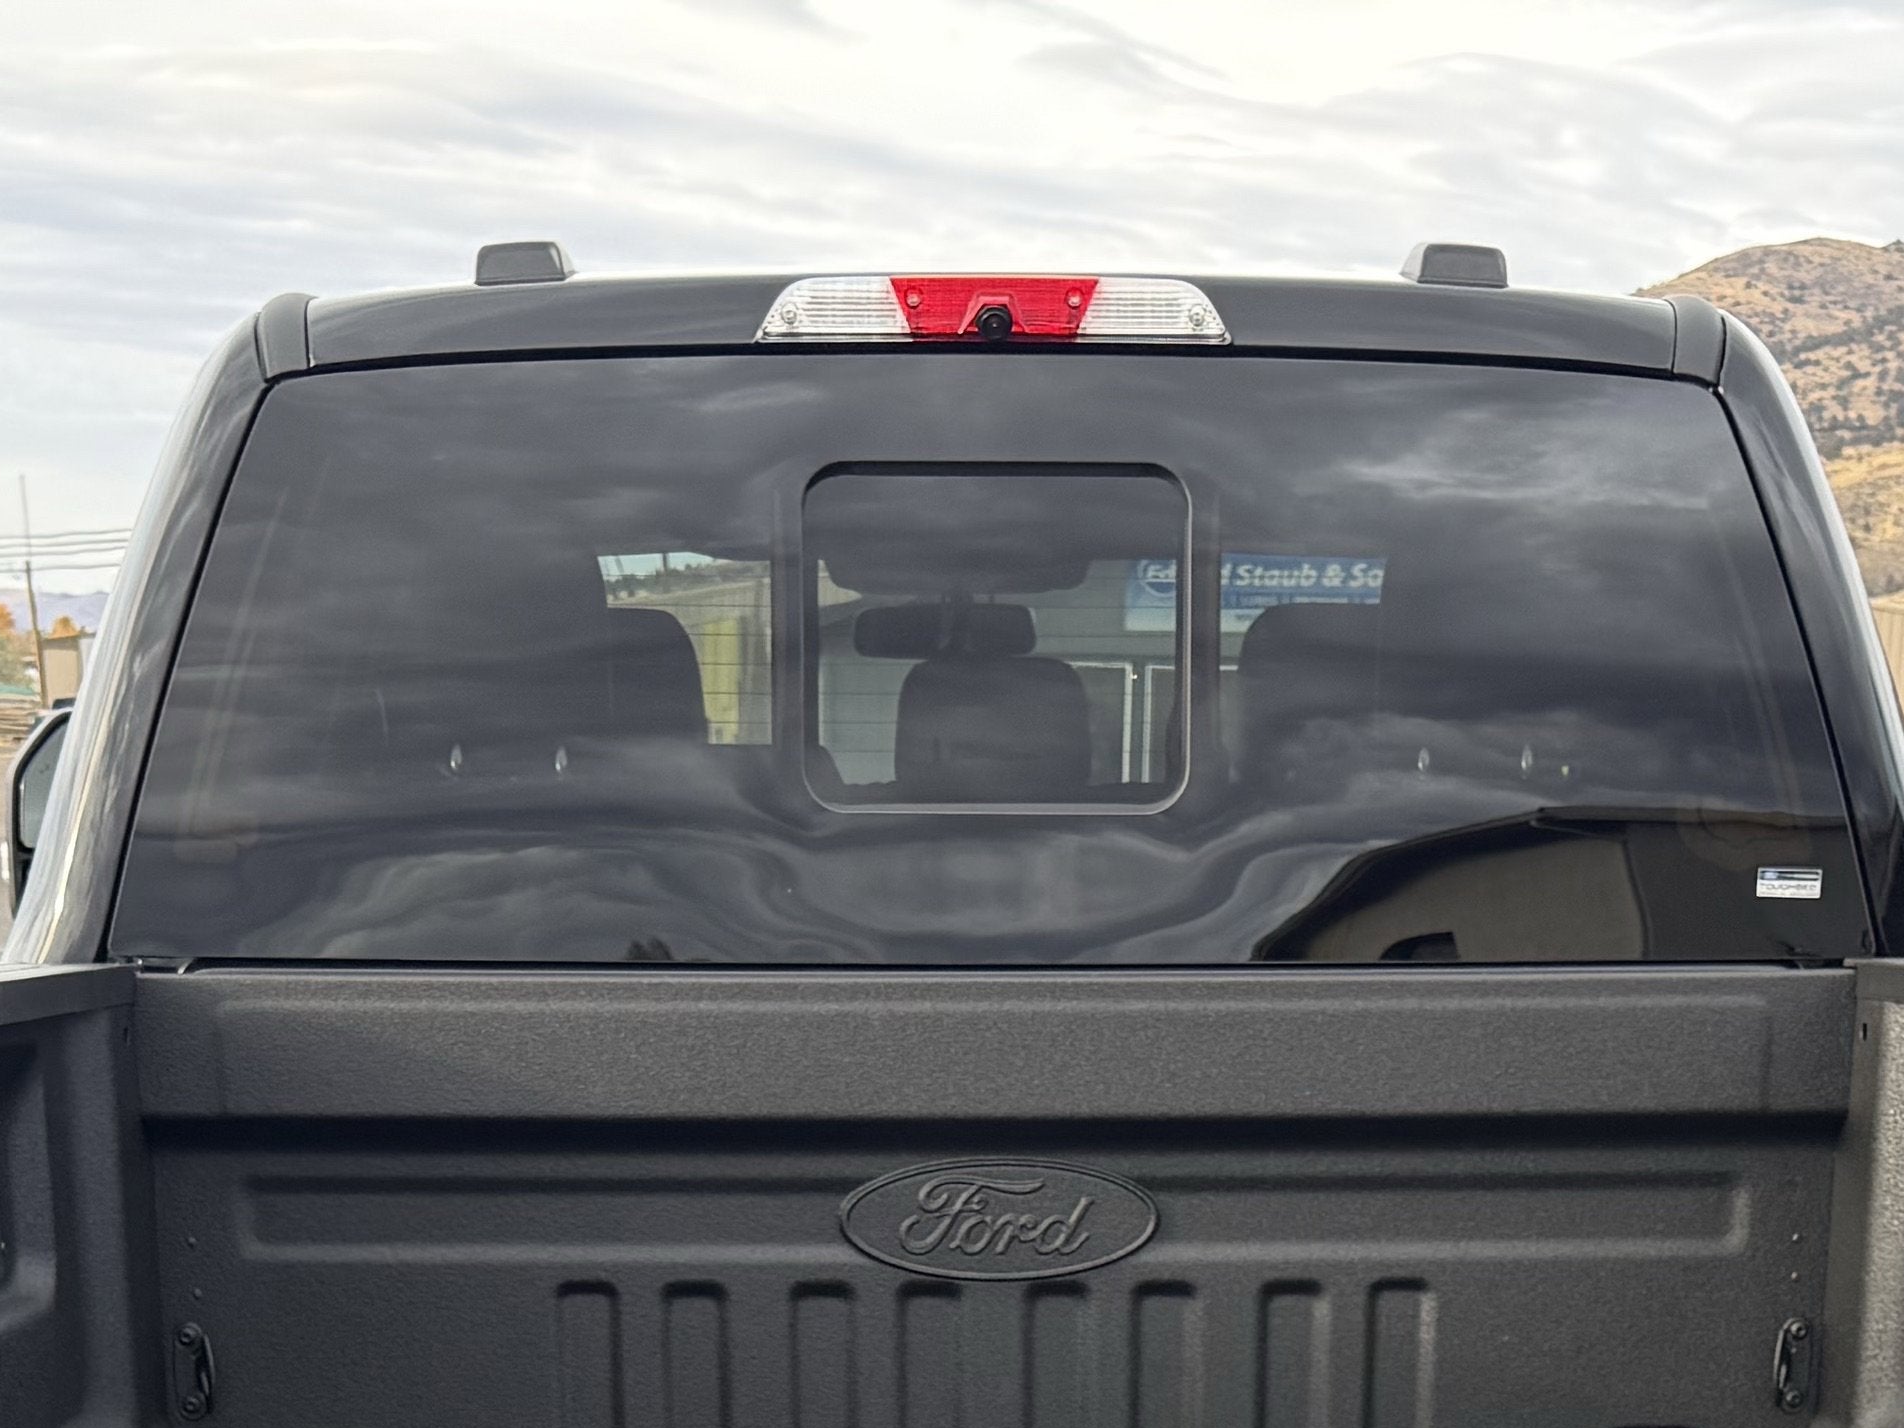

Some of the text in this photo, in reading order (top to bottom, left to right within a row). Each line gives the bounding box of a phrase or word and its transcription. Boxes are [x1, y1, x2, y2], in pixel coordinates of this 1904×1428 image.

[1235, 563, 1317, 587] Staub
[1322, 563, 1346, 588] &
[898, 1173, 1095, 1257] Ford
